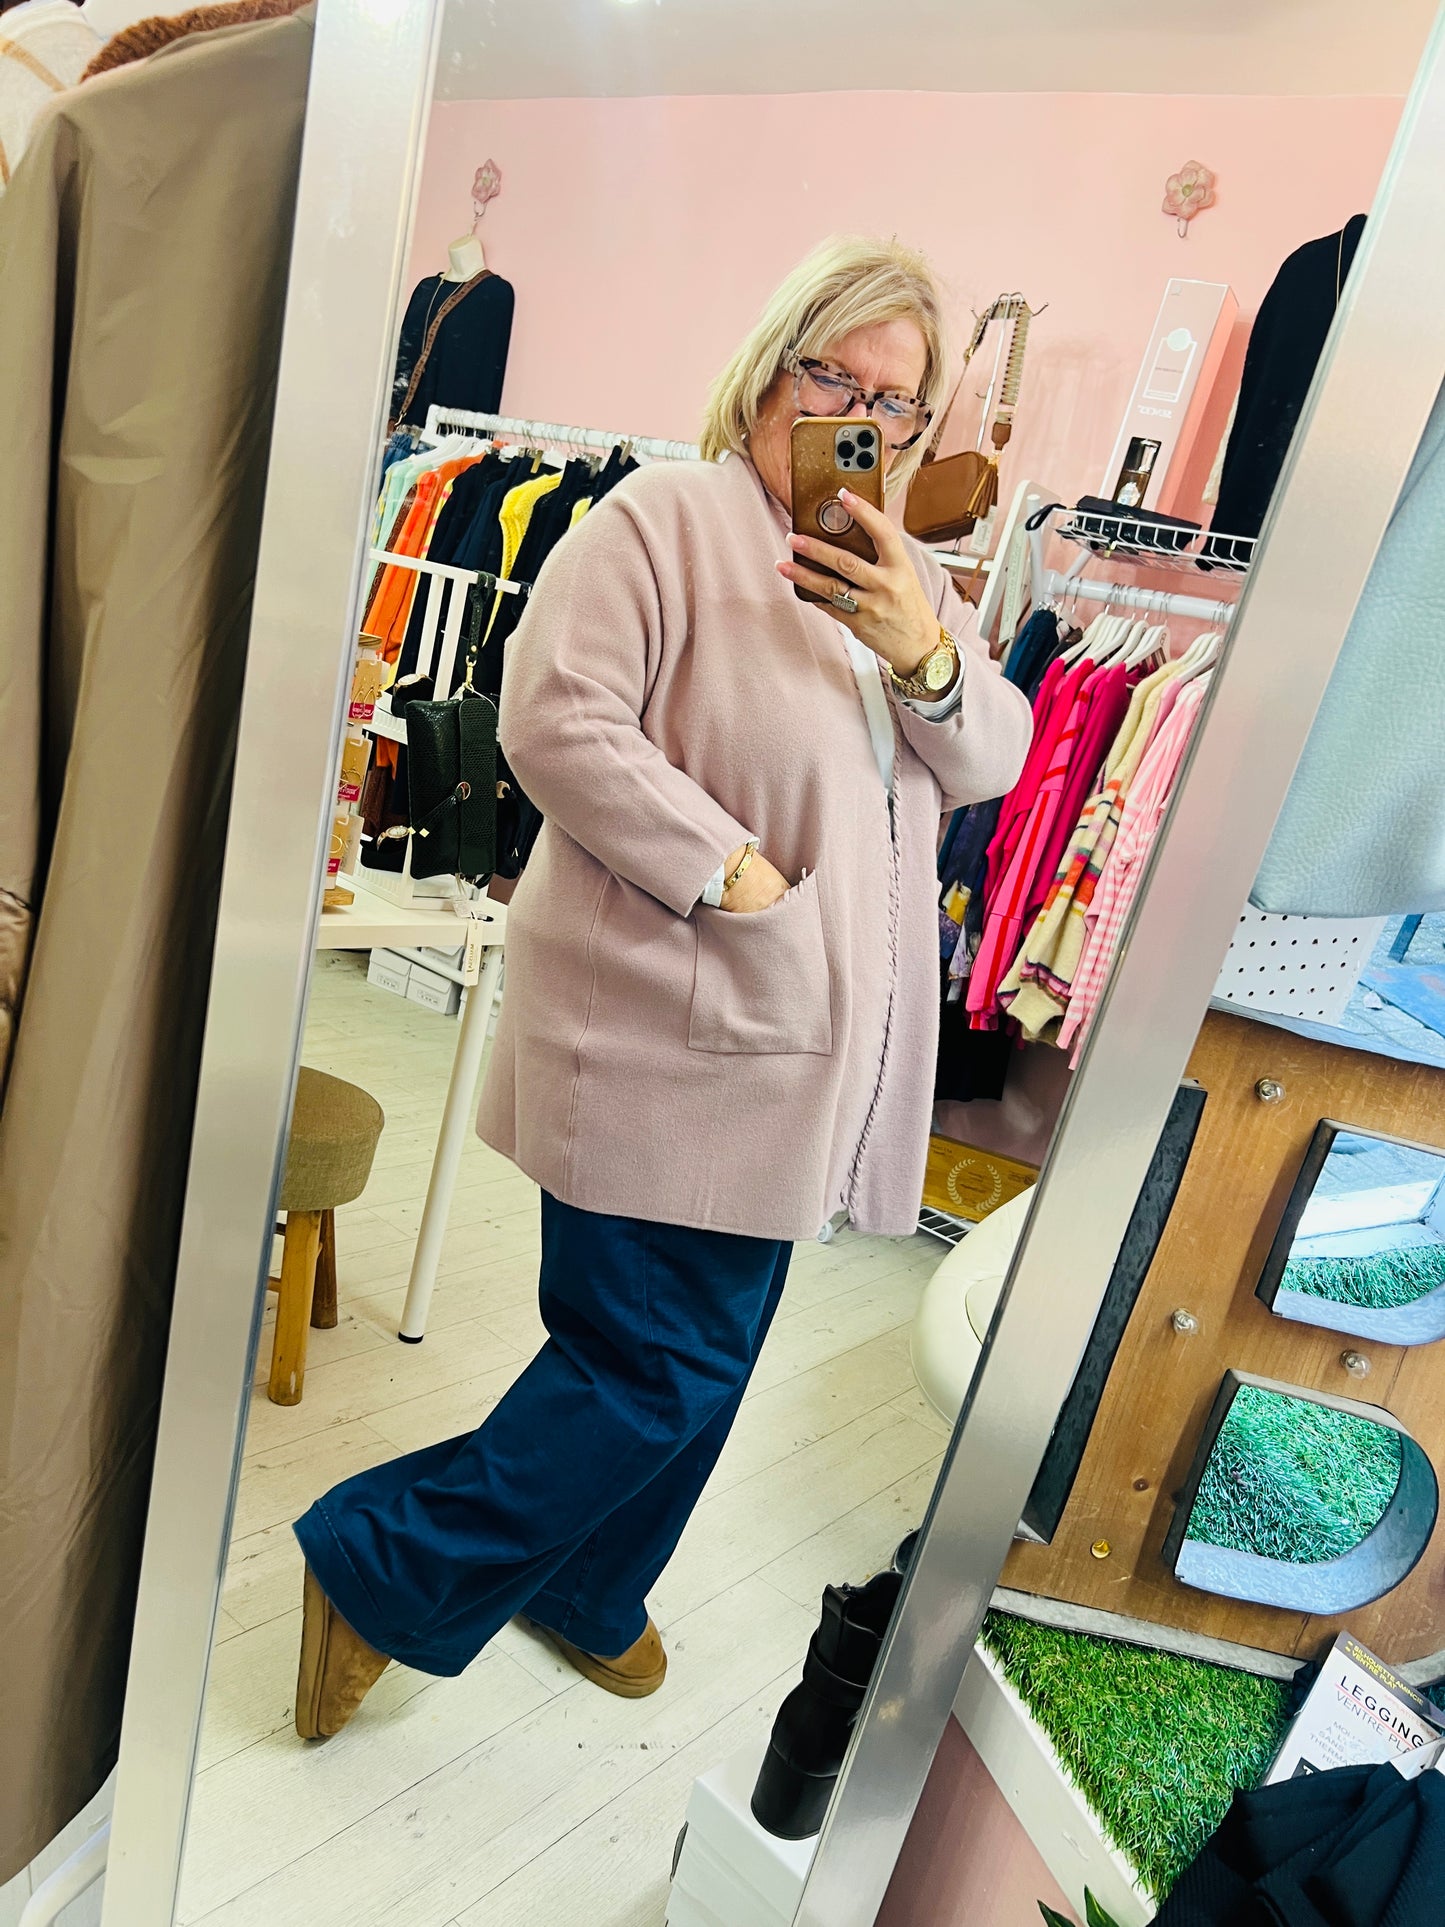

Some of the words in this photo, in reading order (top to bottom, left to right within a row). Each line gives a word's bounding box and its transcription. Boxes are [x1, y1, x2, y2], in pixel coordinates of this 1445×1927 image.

[1352, 1650, 1380, 1676] VENTRE
[1379, 1673, 1398, 1690] PLAT
[1353, 1645, 1396, 1682] SILHOUETTE
[1336, 1690, 1385, 1736] VENTRE
[1340, 1675, 1424, 1749] LEGGING
